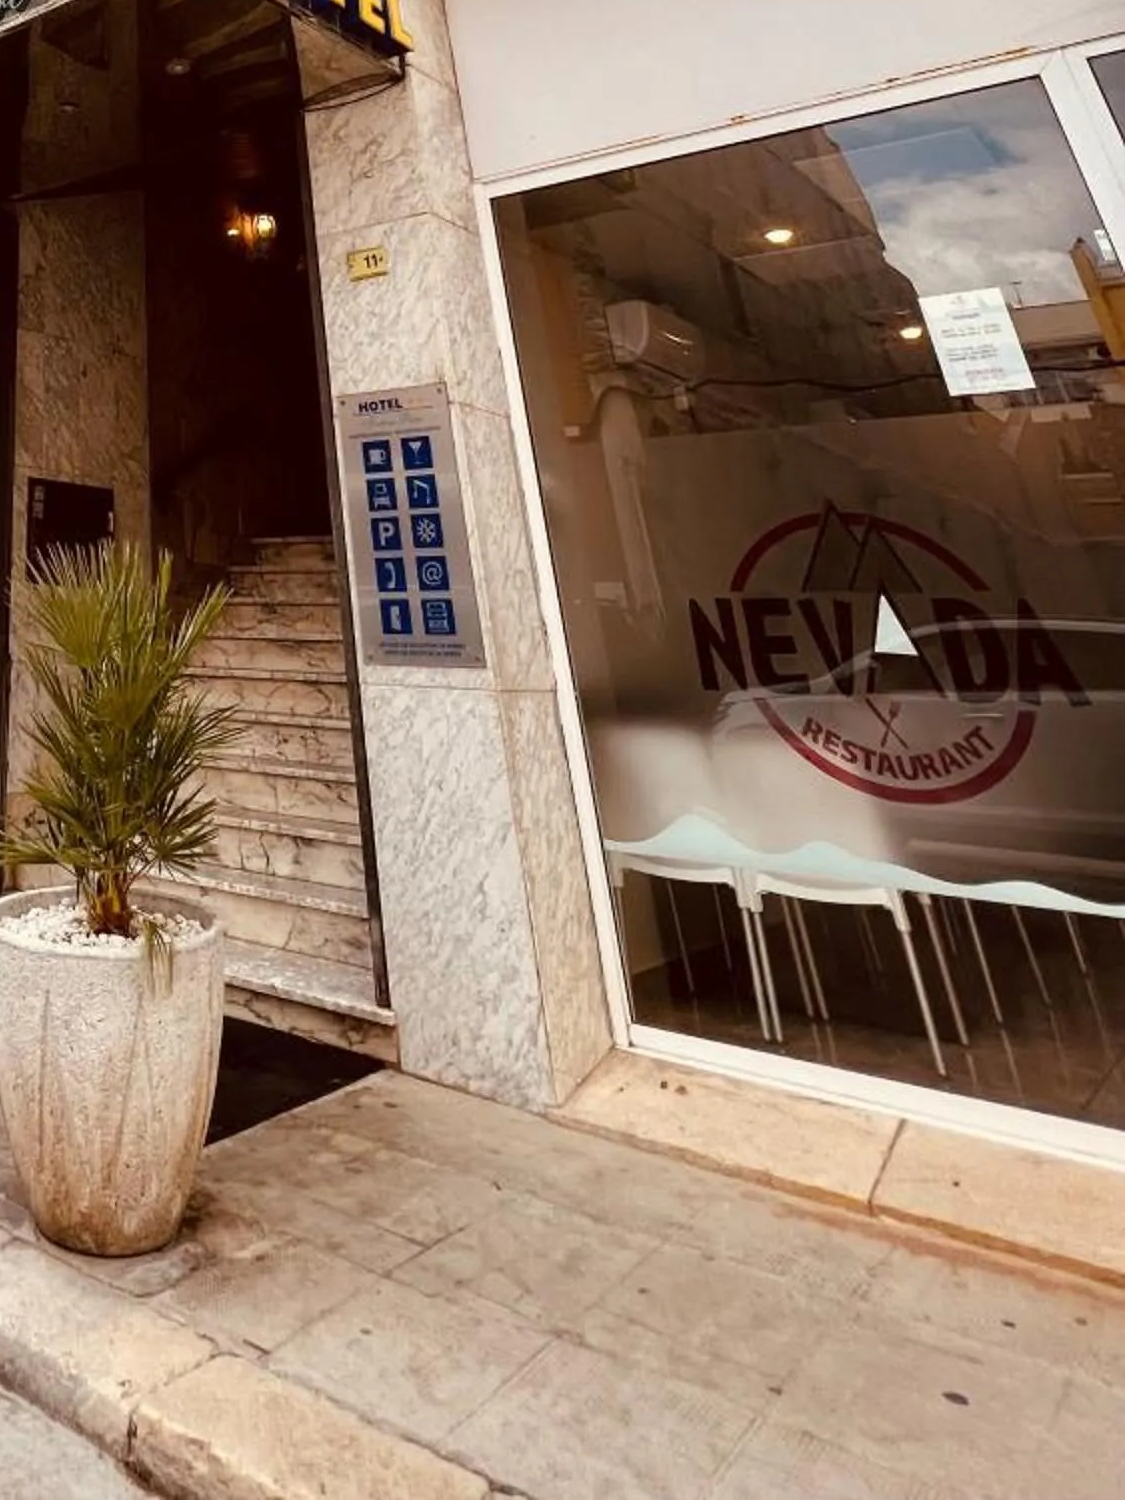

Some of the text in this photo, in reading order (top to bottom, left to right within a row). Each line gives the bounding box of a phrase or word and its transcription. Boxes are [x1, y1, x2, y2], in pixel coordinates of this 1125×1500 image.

[357, 398, 404, 414] HOTEL
[378, 521, 396, 547] P
[688, 590, 1093, 706] NEVADA
[801, 716, 995, 781] RESTAURANT
